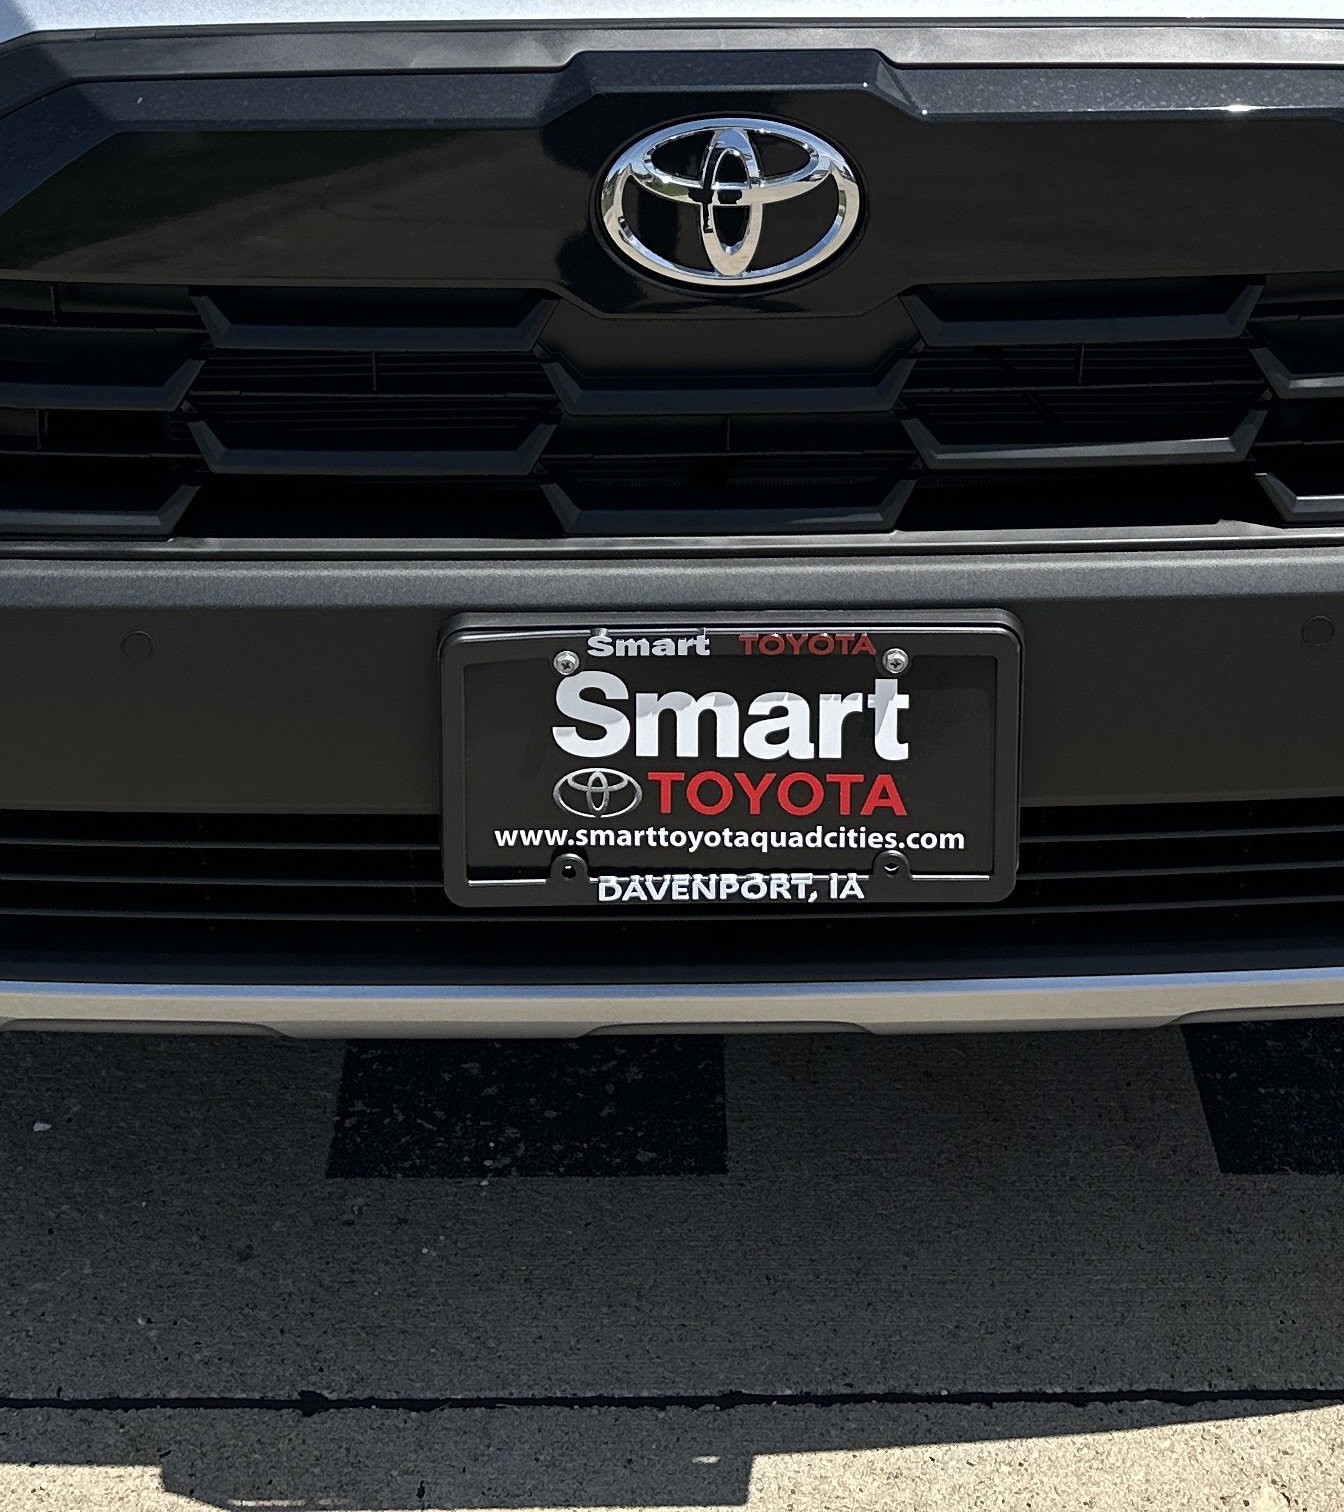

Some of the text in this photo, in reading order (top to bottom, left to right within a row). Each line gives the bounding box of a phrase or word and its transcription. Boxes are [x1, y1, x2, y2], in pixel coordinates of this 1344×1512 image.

[587, 629, 877, 657] Smart TOYOTA
[552, 670, 910, 760] Smart
[647, 770, 908, 817] TOYOTA
[494, 824, 965, 854] www.smarttoyotaquadcities.com
[598, 873, 865, 903] DAVENPORT, IA
